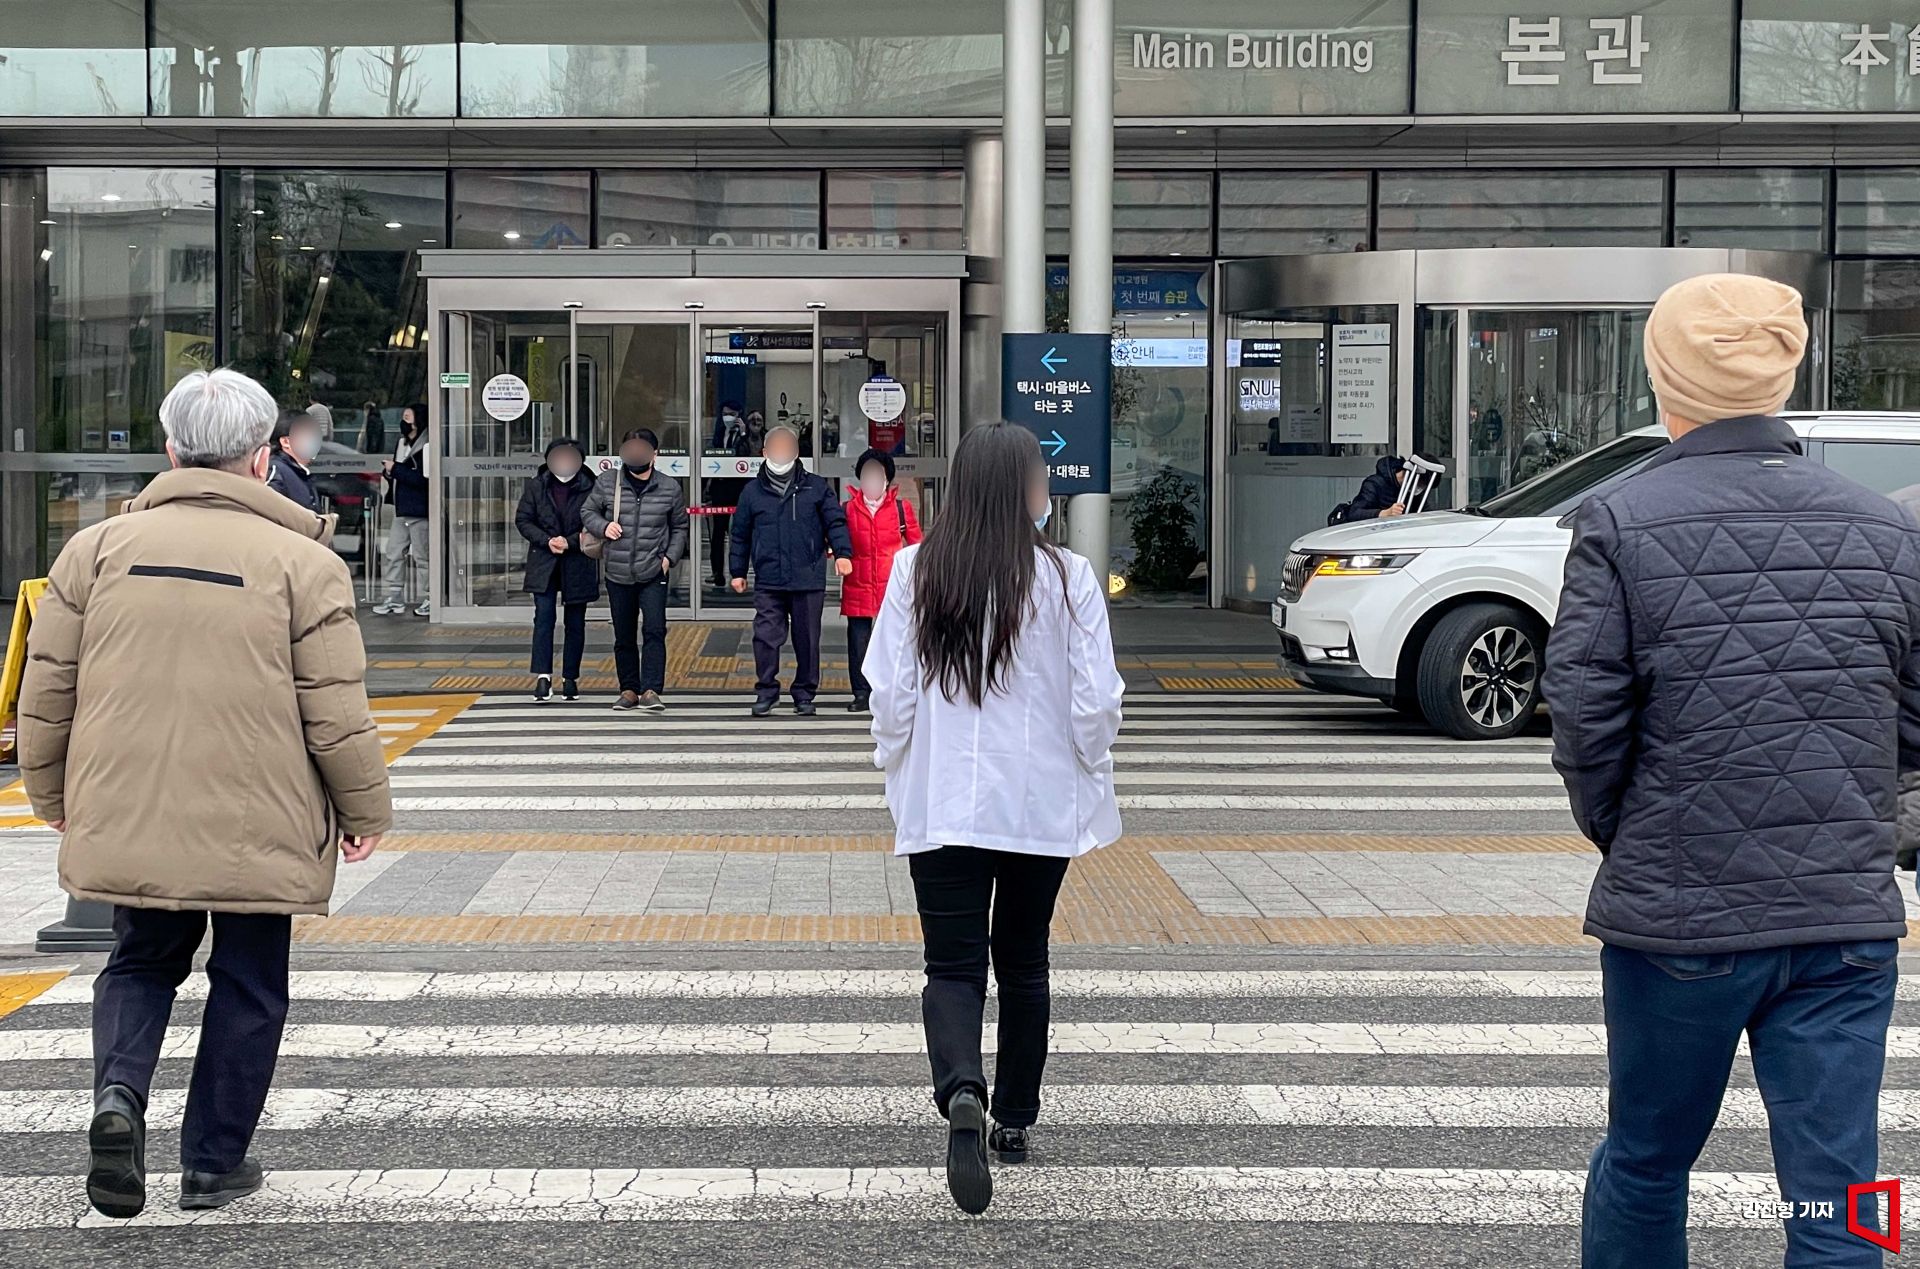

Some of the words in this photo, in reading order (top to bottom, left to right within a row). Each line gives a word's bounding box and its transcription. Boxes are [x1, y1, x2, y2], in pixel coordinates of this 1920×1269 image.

[1133, 33, 1214, 68] Main
[1227, 33, 1374, 73] Building
[1840, 23, 1920, 76] 本
[1121, 289, 1133, 305] 첫
[1137, 289, 1160, 305] 번째
[1164, 290, 1188, 304] 습관
[1131, 346, 1154, 360] 안내
[1017, 380, 1092, 395] 택시·마을버스
[1034, 399, 1058, 413] 타는
[1061, 400, 1074, 413] 곳
